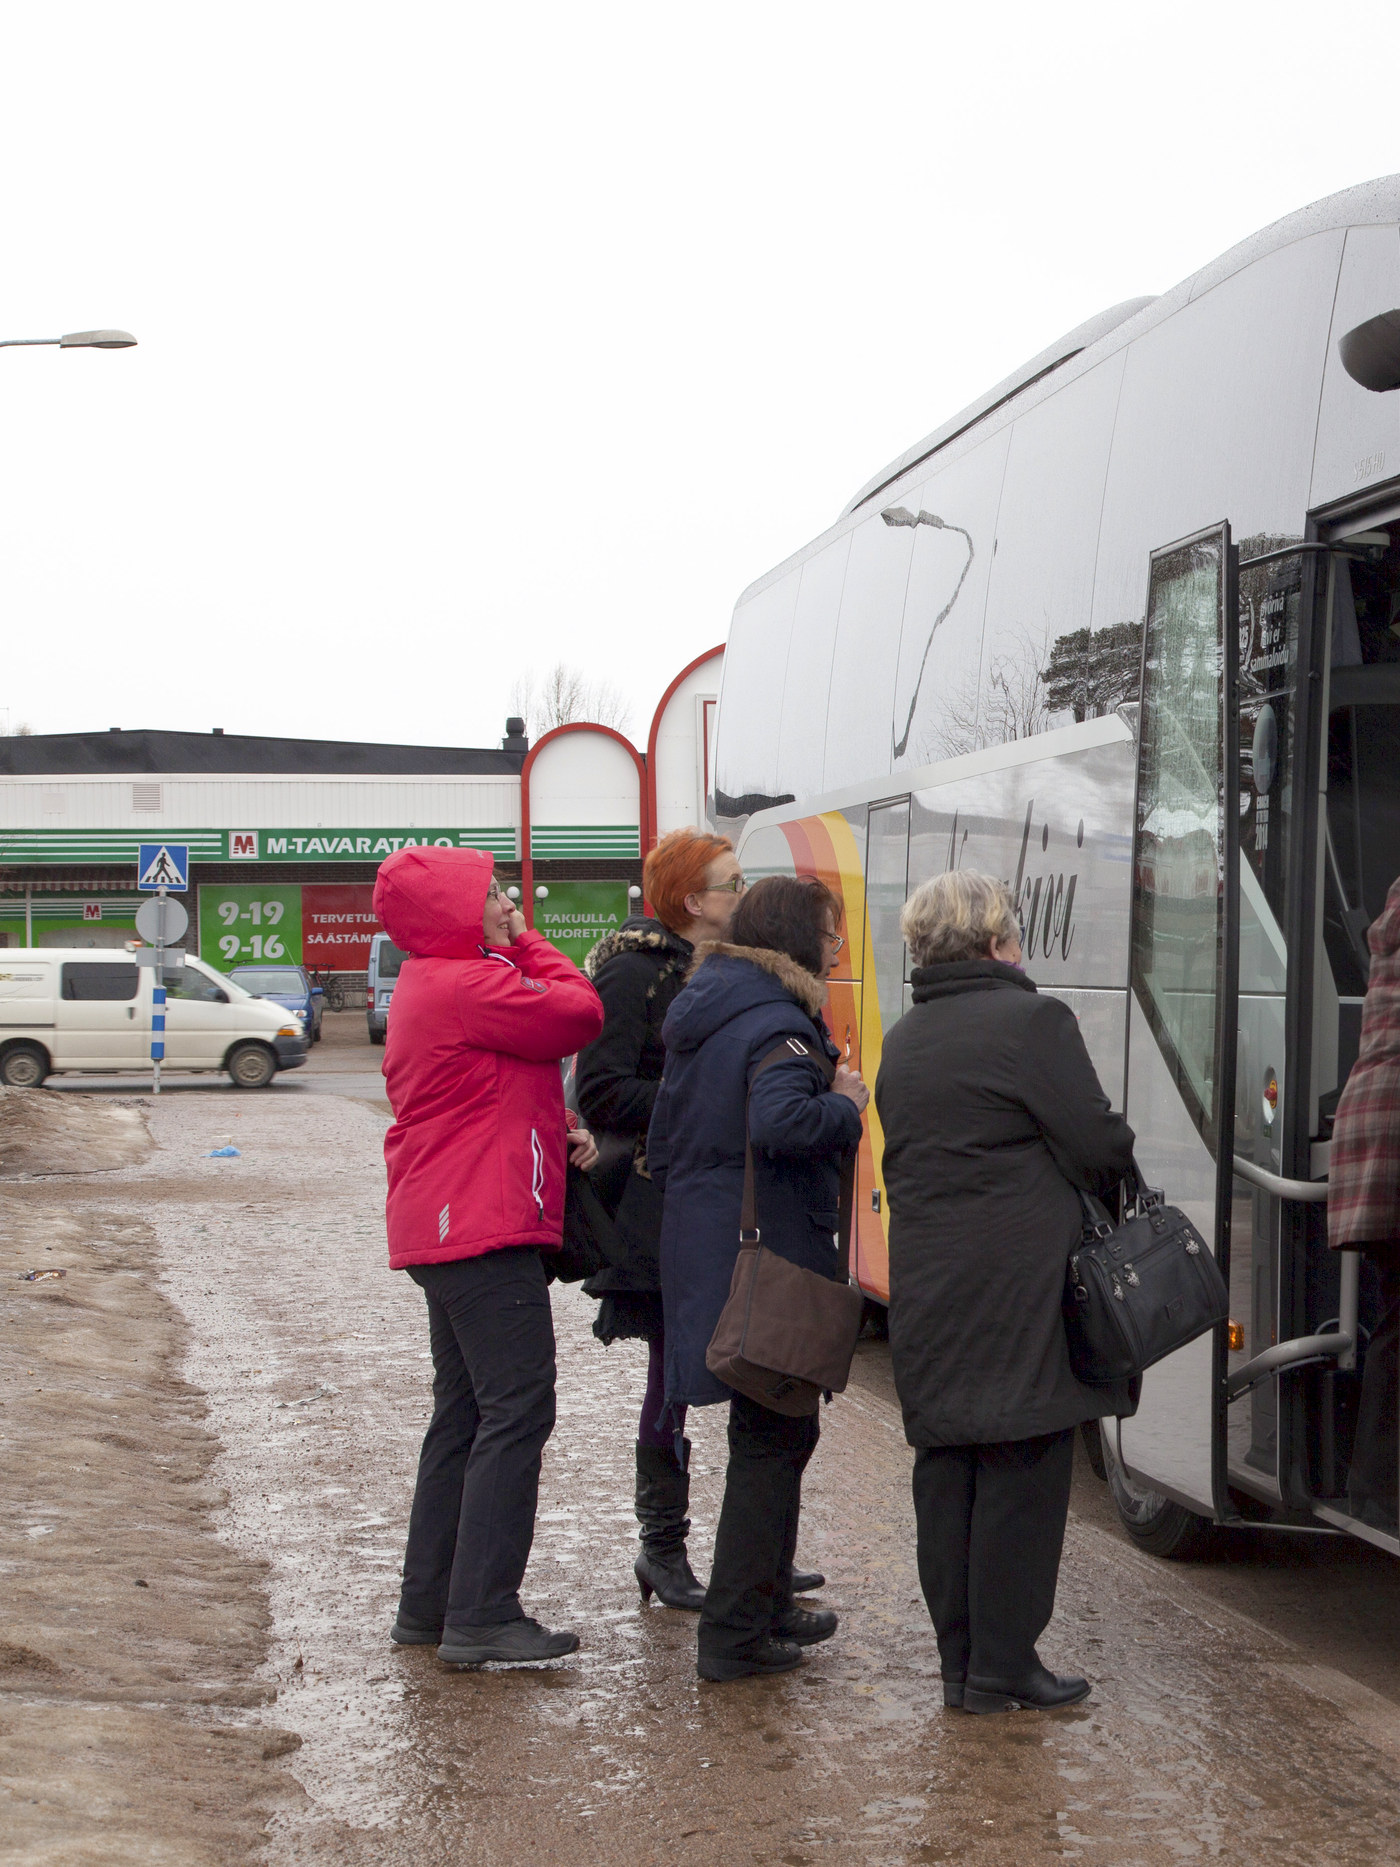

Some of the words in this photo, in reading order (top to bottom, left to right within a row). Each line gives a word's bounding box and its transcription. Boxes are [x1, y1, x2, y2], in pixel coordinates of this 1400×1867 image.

[218, 901, 285, 926] 9-19
[312, 913, 378, 923] TERVETUL
[543, 913, 618, 924] TAKUULLA
[307, 932, 372, 944] SÄÄSTÄM
[218, 934, 286, 959] 9-16
